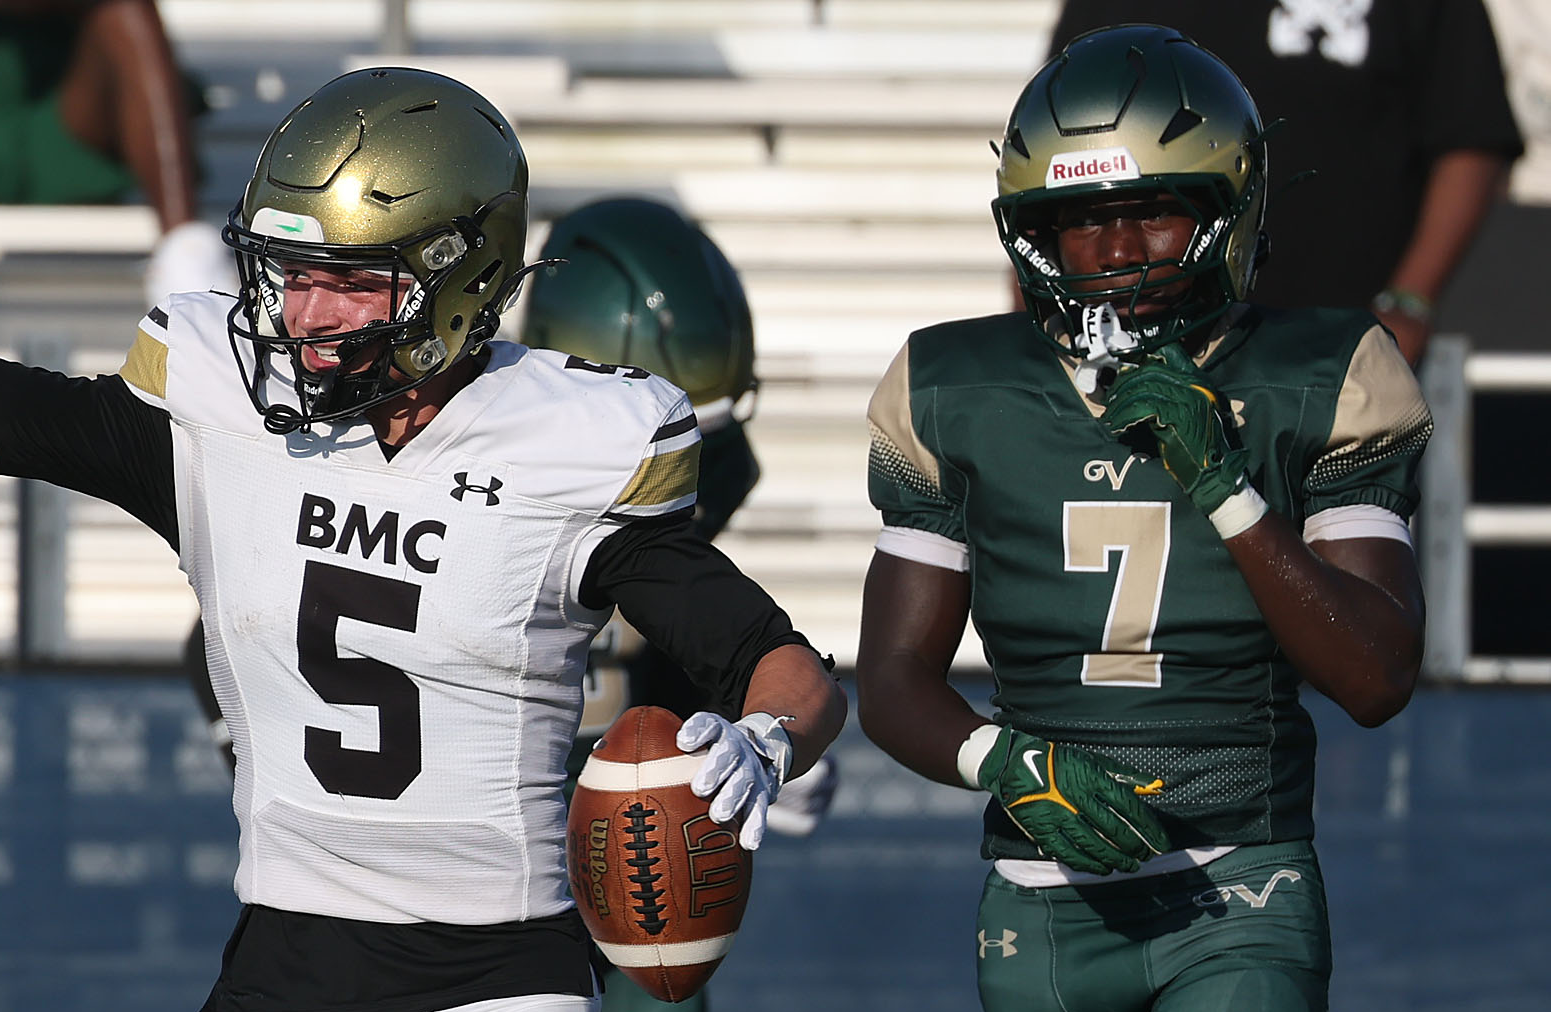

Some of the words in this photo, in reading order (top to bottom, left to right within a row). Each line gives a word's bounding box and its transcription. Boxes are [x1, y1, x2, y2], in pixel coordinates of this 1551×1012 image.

[1053, 155, 1127, 180] Riddell
[296, 492, 448, 574] BMC
[1062, 501, 1172, 688] 7
[296, 559, 422, 801] 5
[589, 817, 610, 917] Wilson
